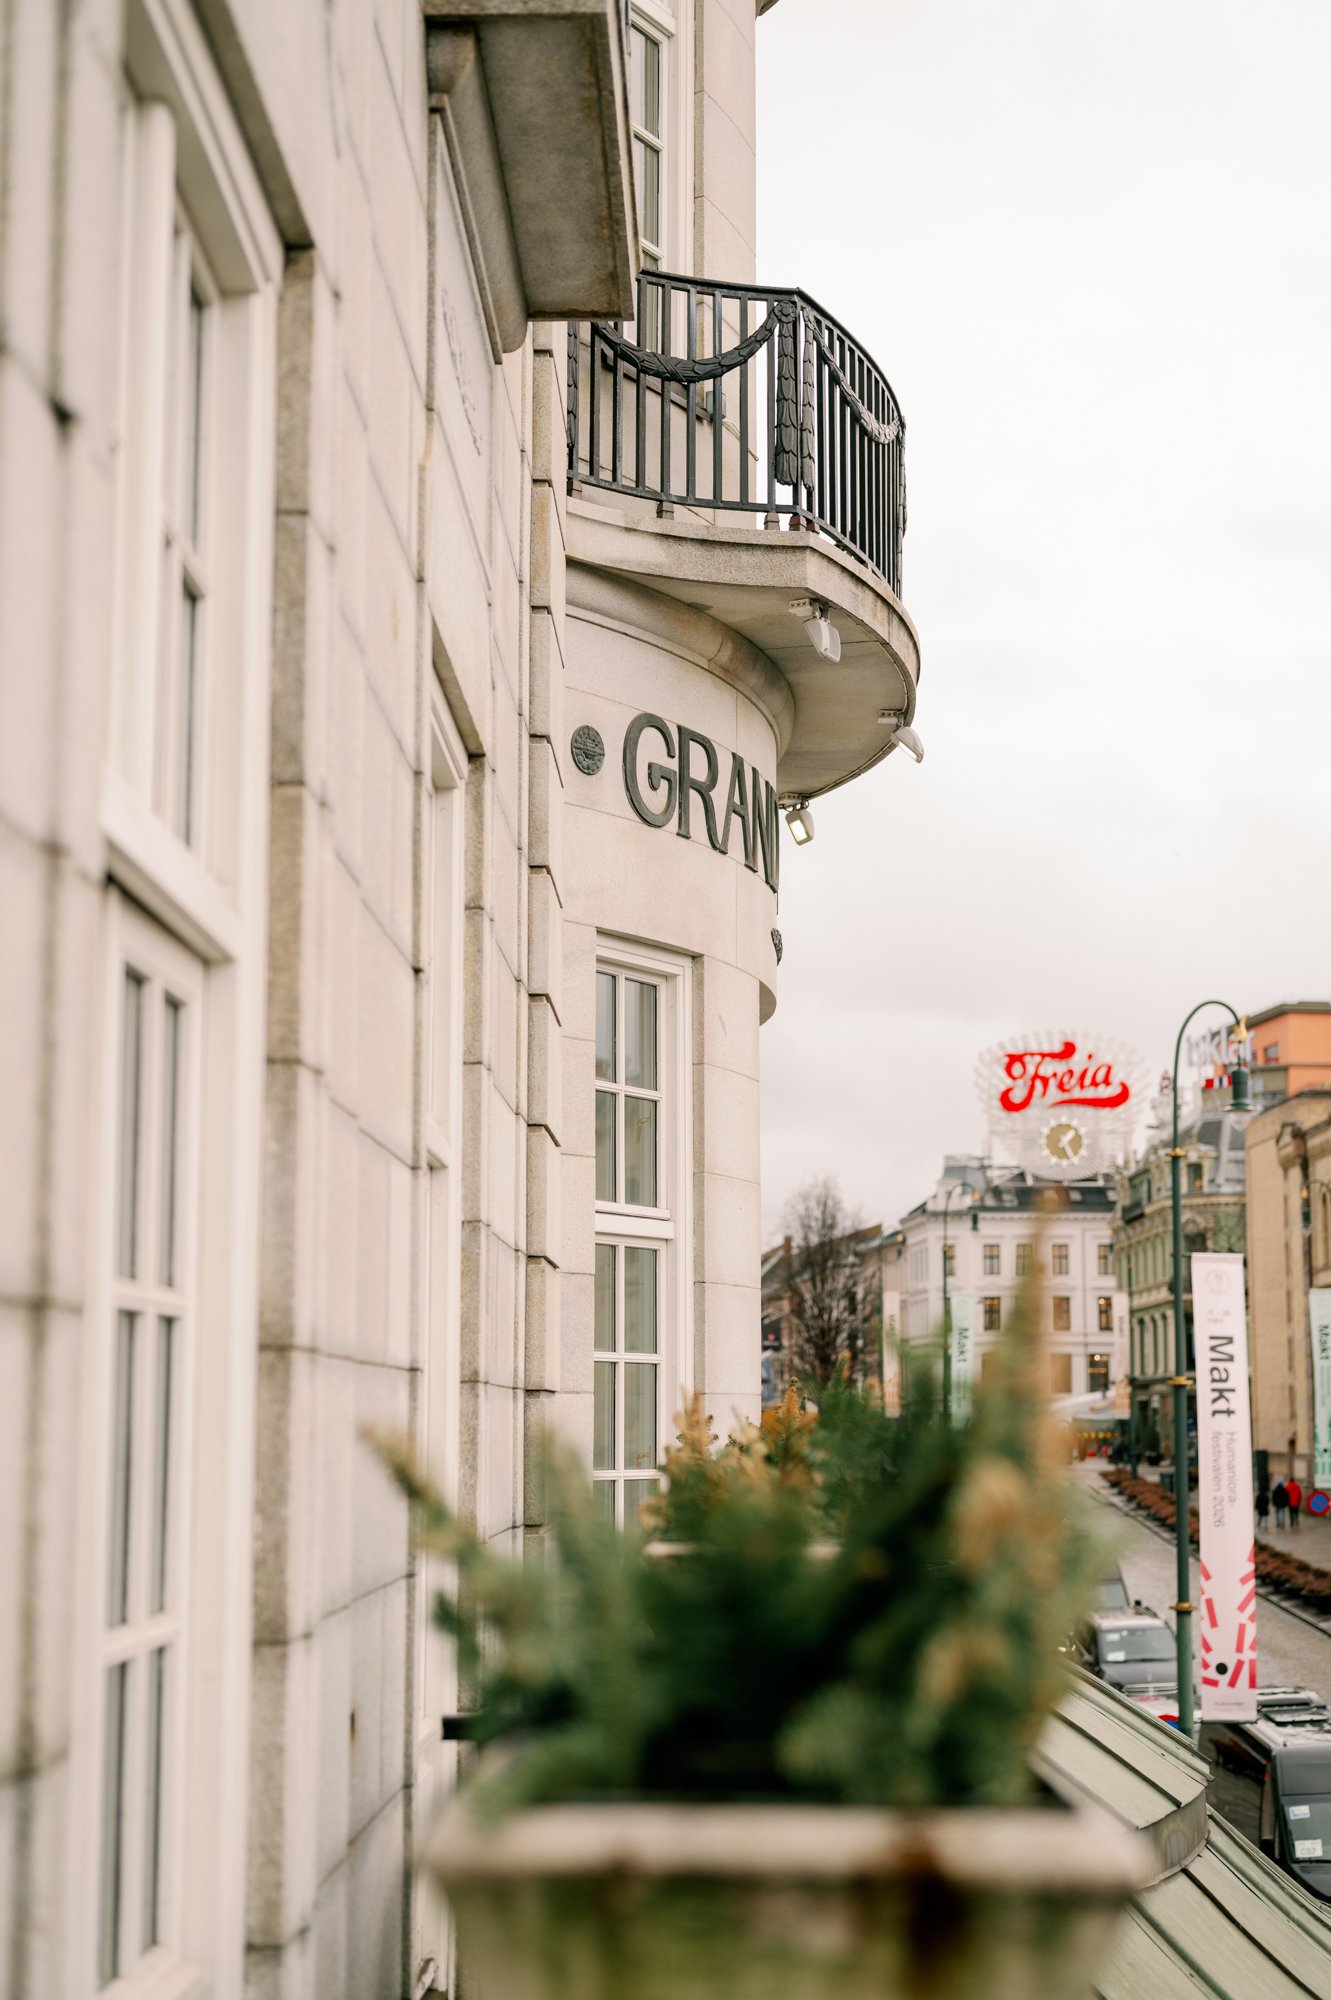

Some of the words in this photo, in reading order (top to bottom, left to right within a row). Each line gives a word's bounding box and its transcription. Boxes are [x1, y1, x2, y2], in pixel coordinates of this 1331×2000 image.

[1000, 1041, 1129, 1112] Freia
[1209, 1335, 1236, 1418] Makt
[1212, 1495, 1225, 1528] 2026
